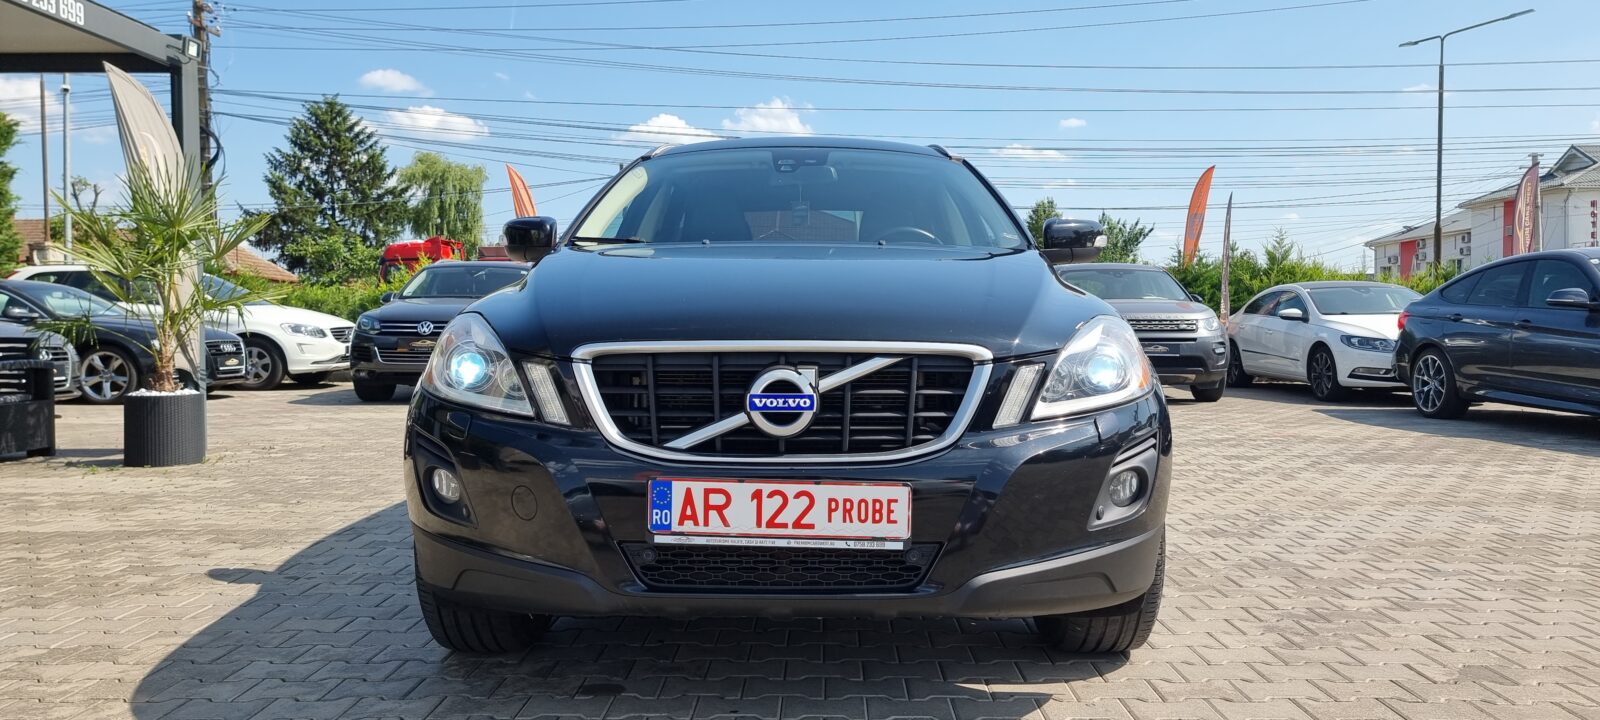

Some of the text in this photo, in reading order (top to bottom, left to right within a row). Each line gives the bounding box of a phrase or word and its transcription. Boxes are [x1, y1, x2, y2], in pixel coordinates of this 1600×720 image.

[59, 0, 85, 26] 699
[752, 398, 811, 407] VOLVO
[652, 509, 671, 525] RO
[677, 487, 899, 530] AR 122 PROBE
